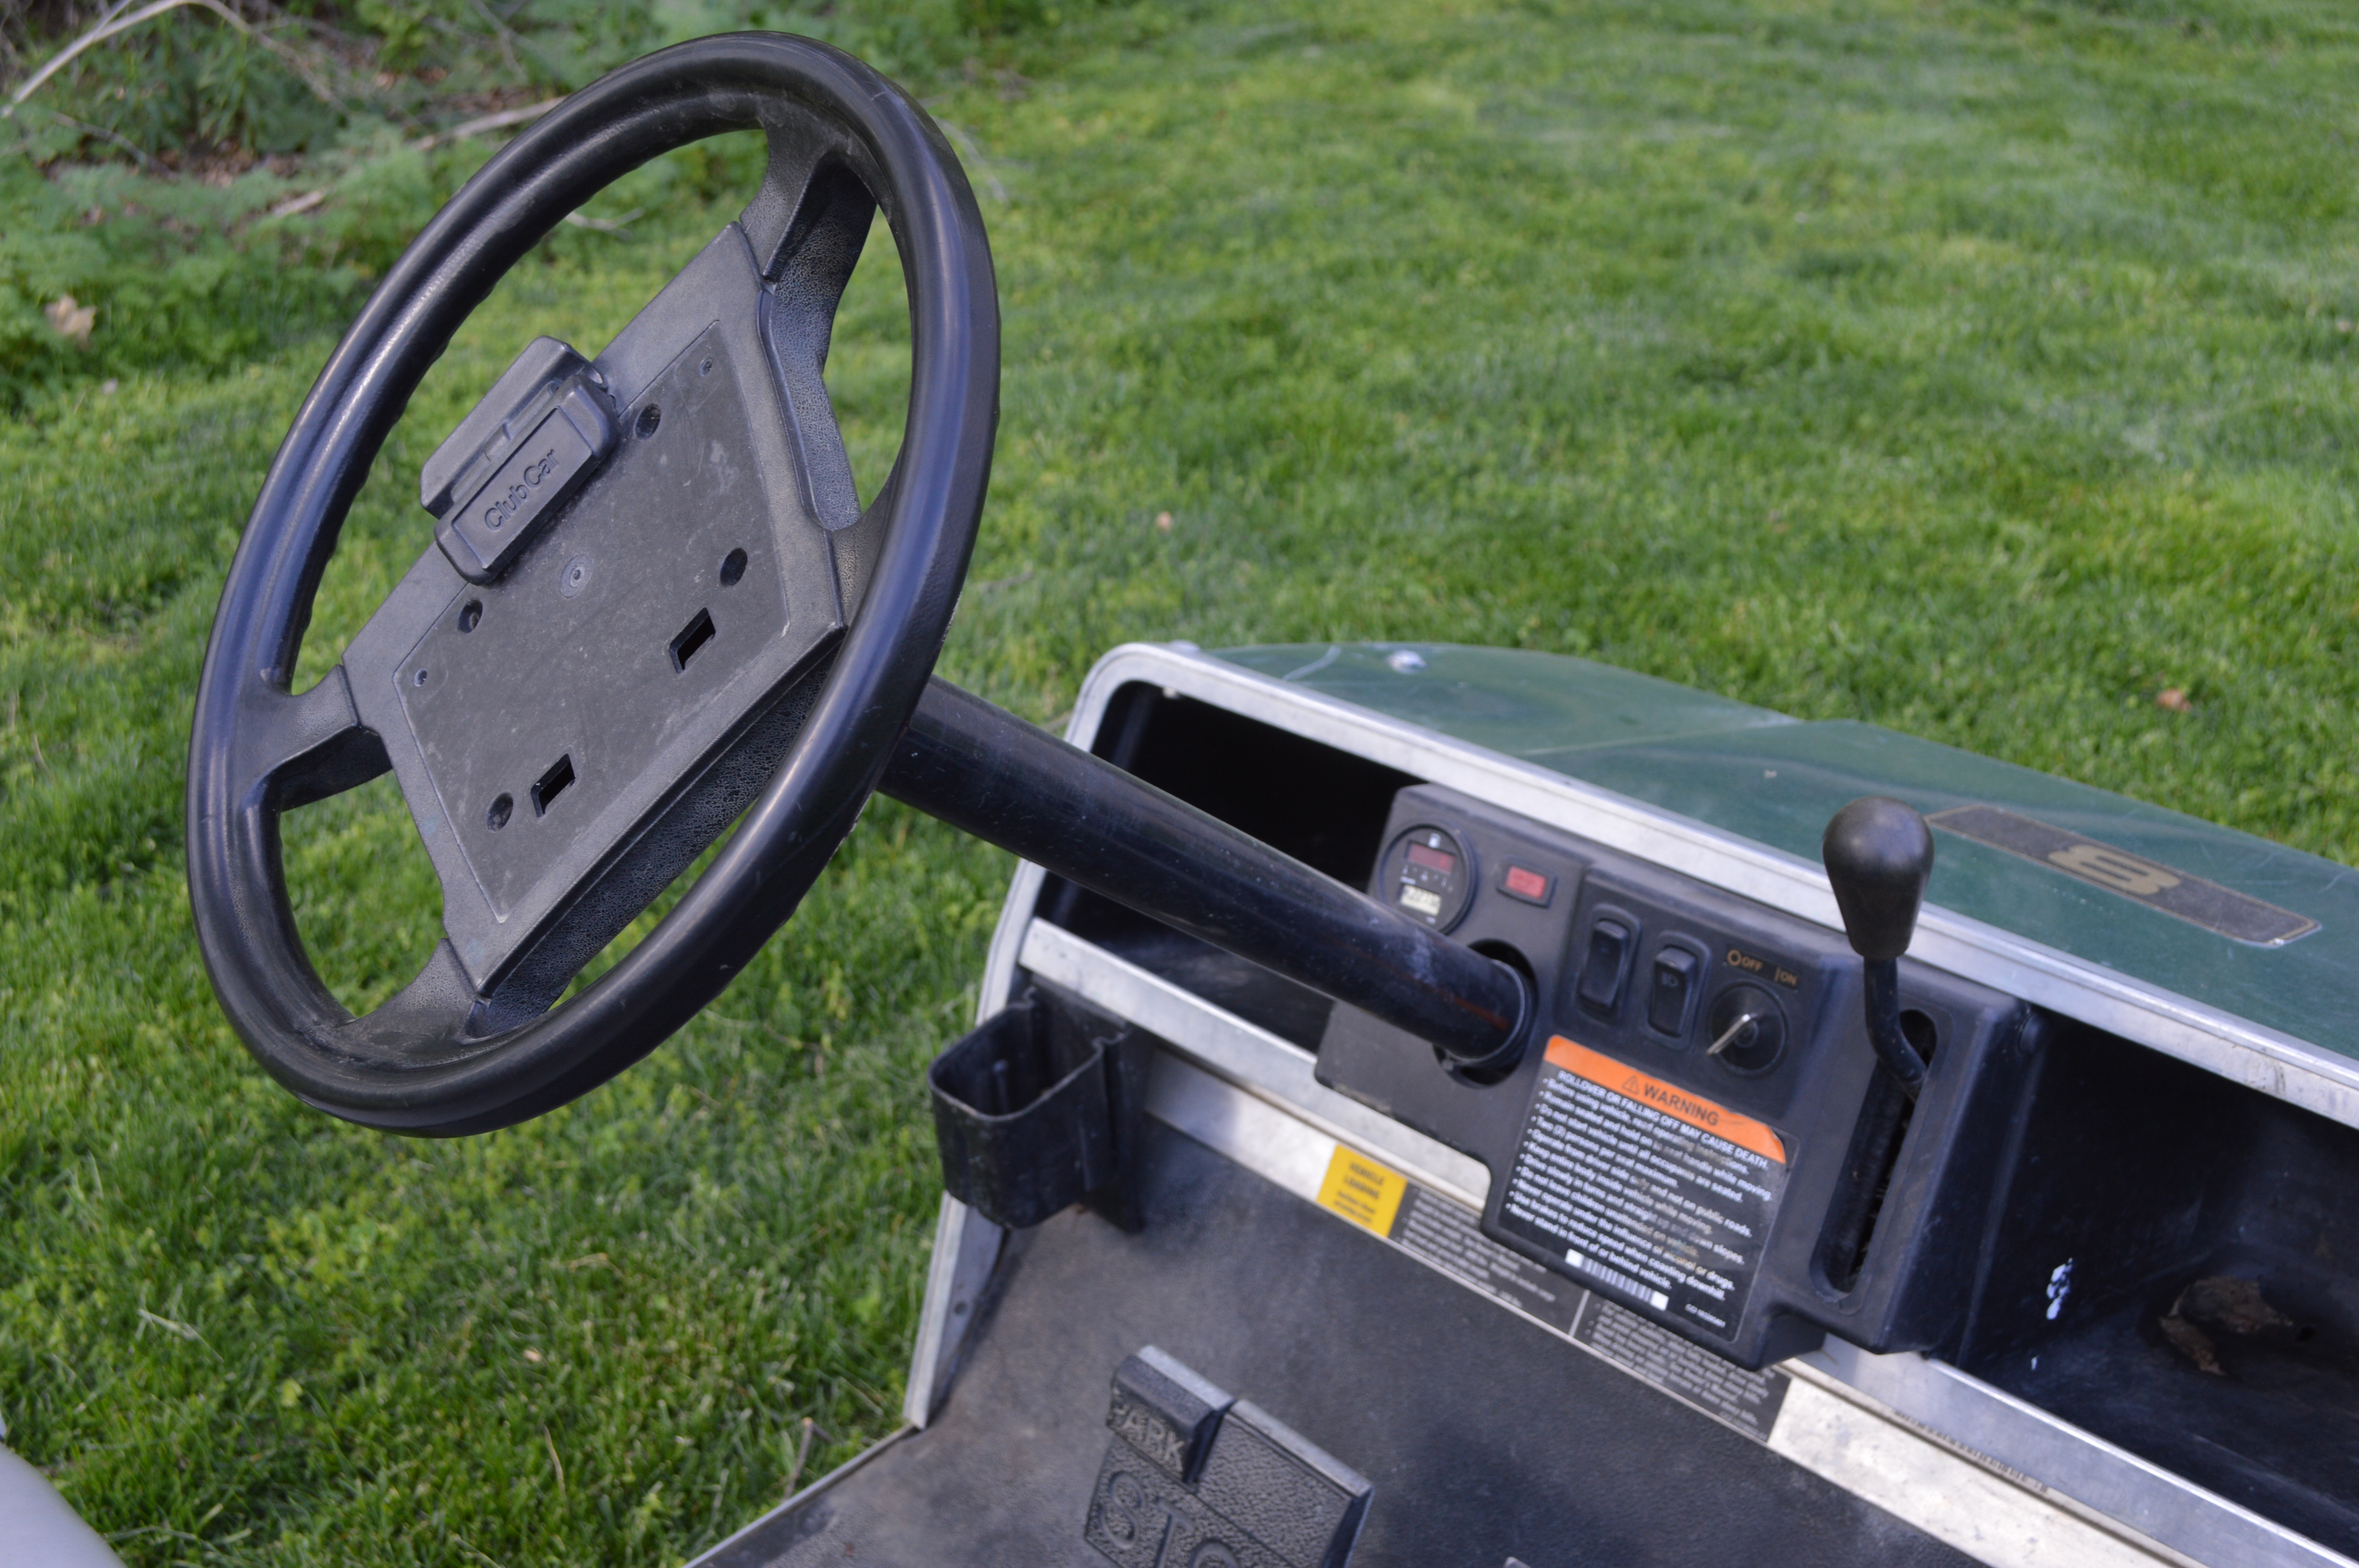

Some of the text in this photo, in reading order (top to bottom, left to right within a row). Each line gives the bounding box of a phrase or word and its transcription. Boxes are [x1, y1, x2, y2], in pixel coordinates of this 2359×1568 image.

[484, 449, 560, 532] Club Car
[1742, 956, 1763, 972] OFF
[1780, 971, 1797, 986] ON
[1543, 1090, 1575, 1113] Remain
[1574, 1106, 1604, 1125] seated
[1602, 1119, 1621, 1133] and
[1619, 1124, 1641, 1142] hold
[1639, 1135, 1653, 1147] on
[1681, 1151, 1713, 1174] handle
[1712, 1168, 1737, 1184] while
[1736, 1178, 1773, 1201] moving.
[1547, 1078, 1575, 1098] Before
[1574, 1092, 1599, 1111] using
[1599, 1103, 1632, 1124] vehicle,
[1632, 1117, 1654, 1133] read
[1652, 1126, 1694, 1152] operating
[1557, 1069, 1770, 1170] ROLLOVER OR FALLING OFF MAY CAUSE DEATH.
[1643, 1082, 1720, 1126] WARNING
[1527, 1140, 1713, 1235] Keep entire body inside vehicle while moving.
[1531, 1128, 1564, 1152] Operate
[1563, 1143, 1585, 1161] from
[1584, 1152, 1611, 1173] driver
[1609, 1166, 1630, 1182] side
[1648, 1184, 1668, 1199] and
[1666, 1192, 1684, 1206] not
[1682, 1199, 1696, 1212] on
[1695, 1205, 1724, 1225] public
[1723, 1218, 1753, 1238] roads.
[1536, 1116, 1554, 1132] Two
[1564, 1131, 1600, 1153] persons
[1599, 1147, 1616, 1160] per
[1614, 1154, 1635, 1169] seat
[1633, 1162, 1679, 1189] maximum.
[1539, 1102, 1744, 1203] Do not start vehicle until all occupants are seated.
[1509, 1203, 1673, 1290] Never stand in front of or behind vehicle.
[1513, 1190, 1726, 1301] Use brakes to reduce speed when coasting downhill.
[1516, 1178, 1542, 1199] Never
[1540, 1192, 1573, 1214] operate
[1572, 1207, 1598, 1226] under
[1597, 1216, 1613, 1232] the
[1611, 1223, 1653, 1251] influence
[1652, 1244, 1664, 1256] of
[1695, 1265, 1707, 1277] or
[1705, 1268, 1736, 1291] drugs.
[1520, 1166, 1534, 1181] Do
[1532, 1174, 1549, 1187] not
[1547, 1178, 1571, 1198] leave
[1570, 1191, 1605, 1214] children
[1604, 1208, 1654, 1237] unattended
[1652, 1230, 1666, 1242] on
[1523, 1153, 1547, 1172] Drive
[1545, 1166, 1574, 1186] slowly
[1572, 1176, 1584, 1190] in
[1582, 1180, 1606, 1200] turns
[1605, 1193, 1624, 1208] and
[1622, 1202, 1658, 1224] straight
[1712, 1244, 1745, 1265] slopes.
